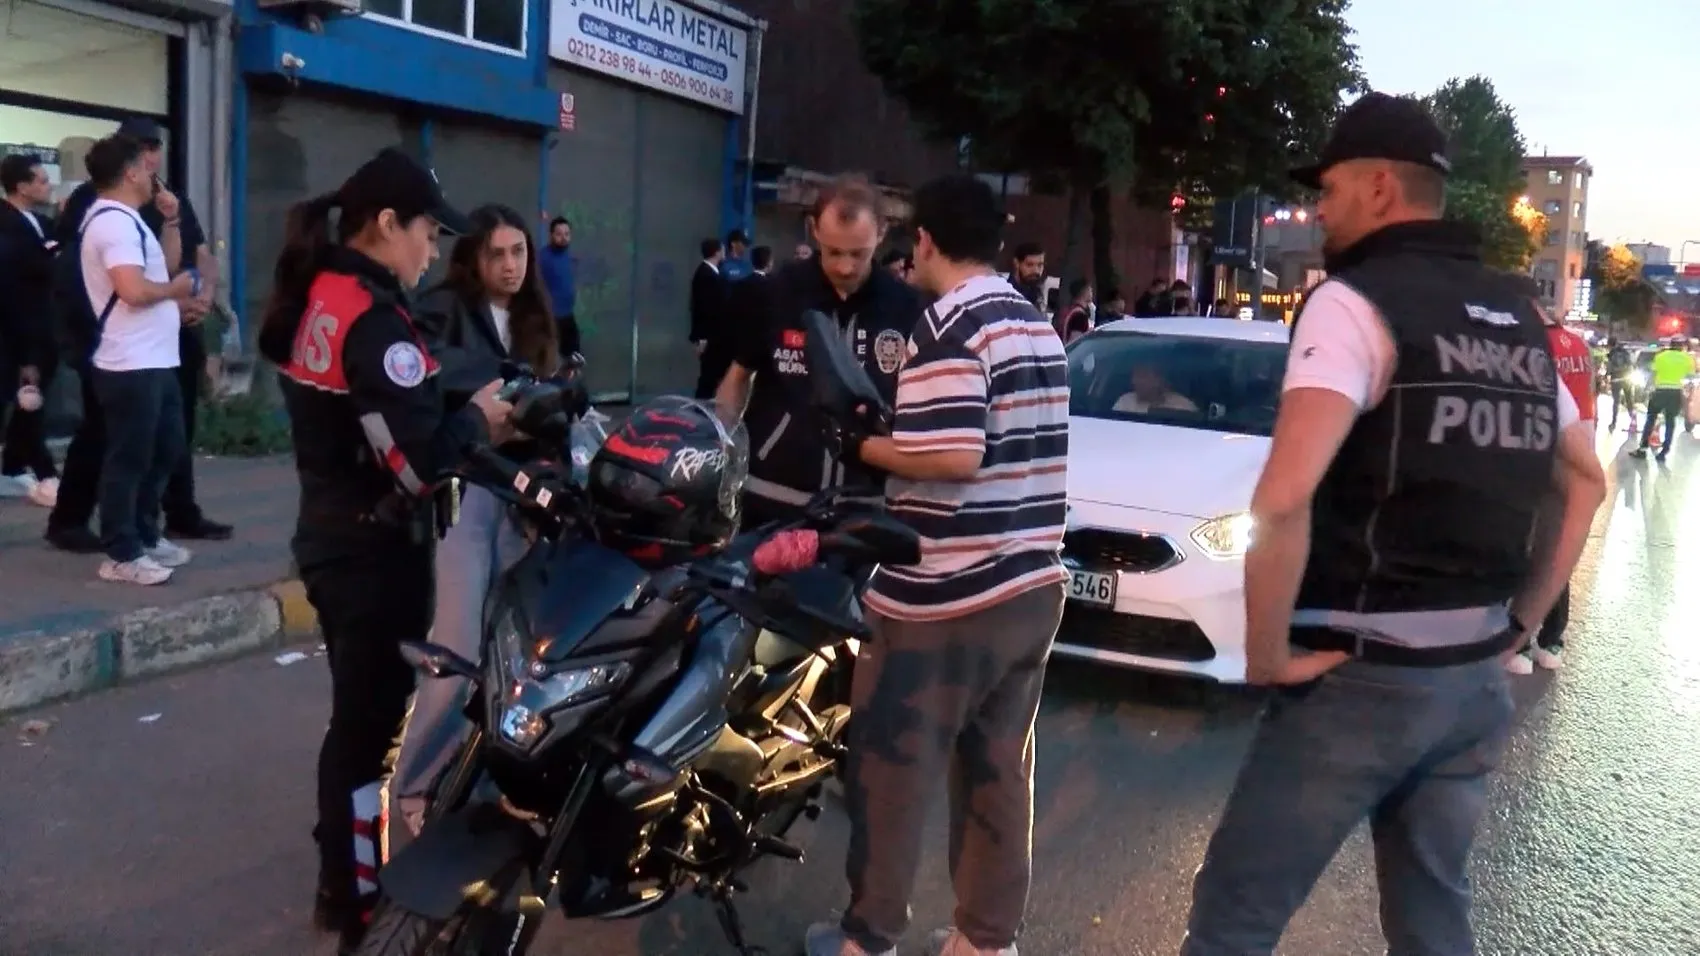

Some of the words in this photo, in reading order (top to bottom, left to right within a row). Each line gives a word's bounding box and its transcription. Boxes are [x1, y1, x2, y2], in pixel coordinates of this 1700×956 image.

[680, 12, 738, 59] METAL
[568, 38, 597, 61] 0212
[599, 47, 620, 69] 238
[622, 55, 637, 73] 98
[660, 68, 687, 90] 0506
[688, 77, 708, 96] 900
[1073, 572, 1110, 600] 546
